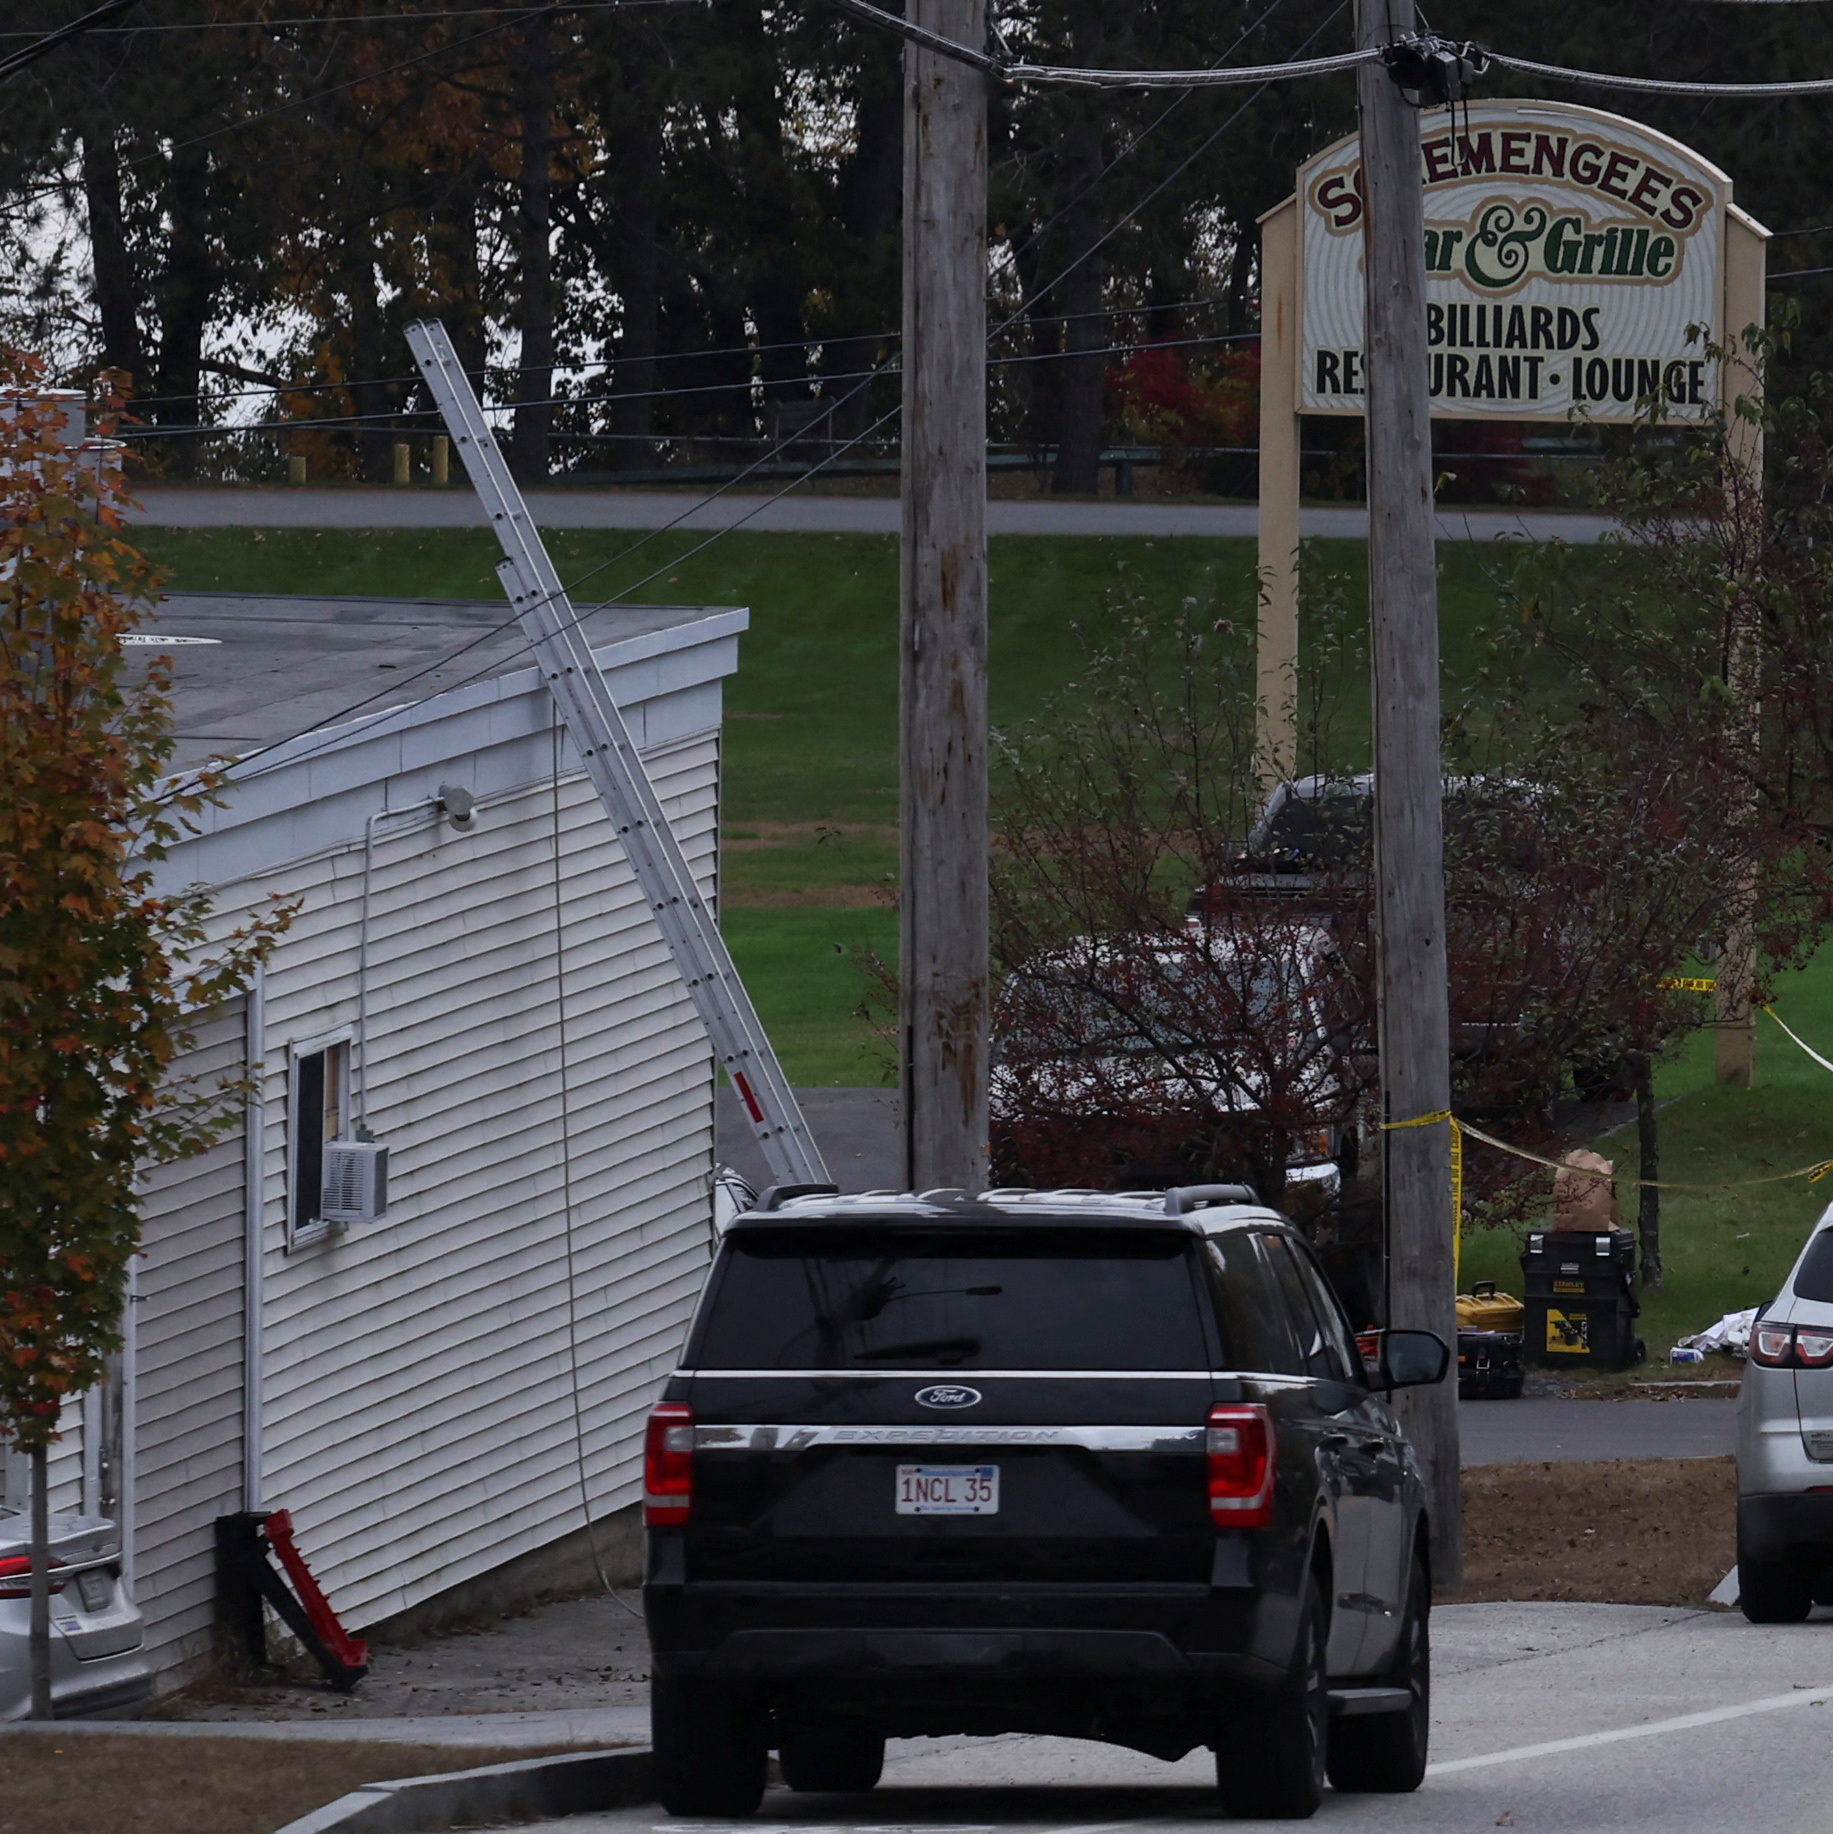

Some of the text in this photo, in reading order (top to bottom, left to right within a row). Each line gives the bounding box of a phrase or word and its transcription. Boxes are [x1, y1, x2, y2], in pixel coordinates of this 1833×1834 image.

[1317, 132, 1703, 229] SEMENGEES
[1425, 205, 1675, 288] ar & Grille
[1427, 303, 1600, 351] BILLIARDS
[1317, 350, 1705, 404] REURANT LOUNGE
[929, 1389, 966, 1404] Ford
[834, 1429, 1059, 1443] EXPEDITION
[965, 1477, 993, 1503] 35
